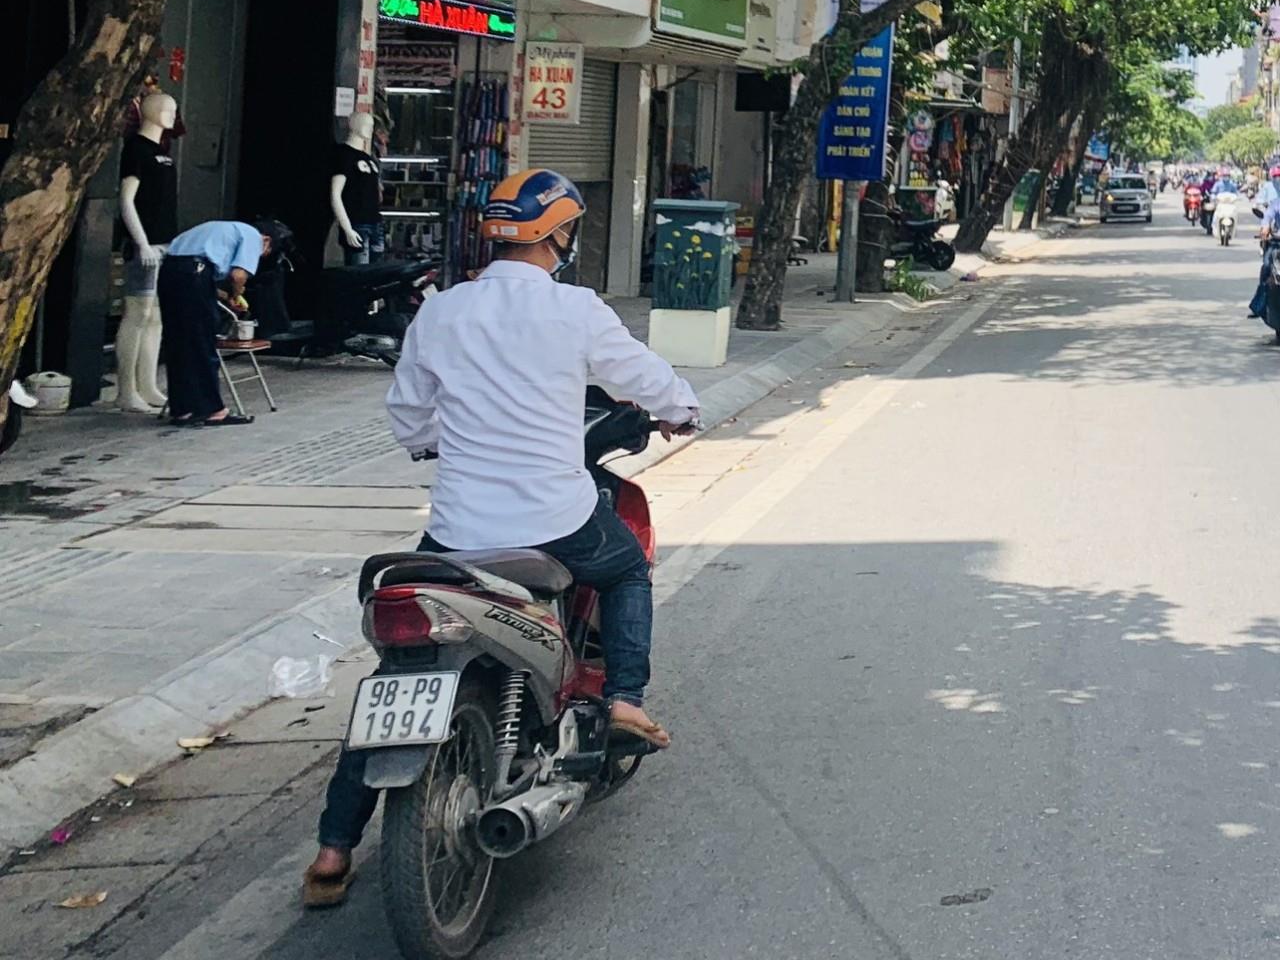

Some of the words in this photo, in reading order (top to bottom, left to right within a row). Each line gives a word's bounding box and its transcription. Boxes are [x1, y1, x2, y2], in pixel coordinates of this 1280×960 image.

[532, 87, 566, 109] 43
[368, 677, 442, 708] 98-P9
[365, 709, 432, 743] 1994
